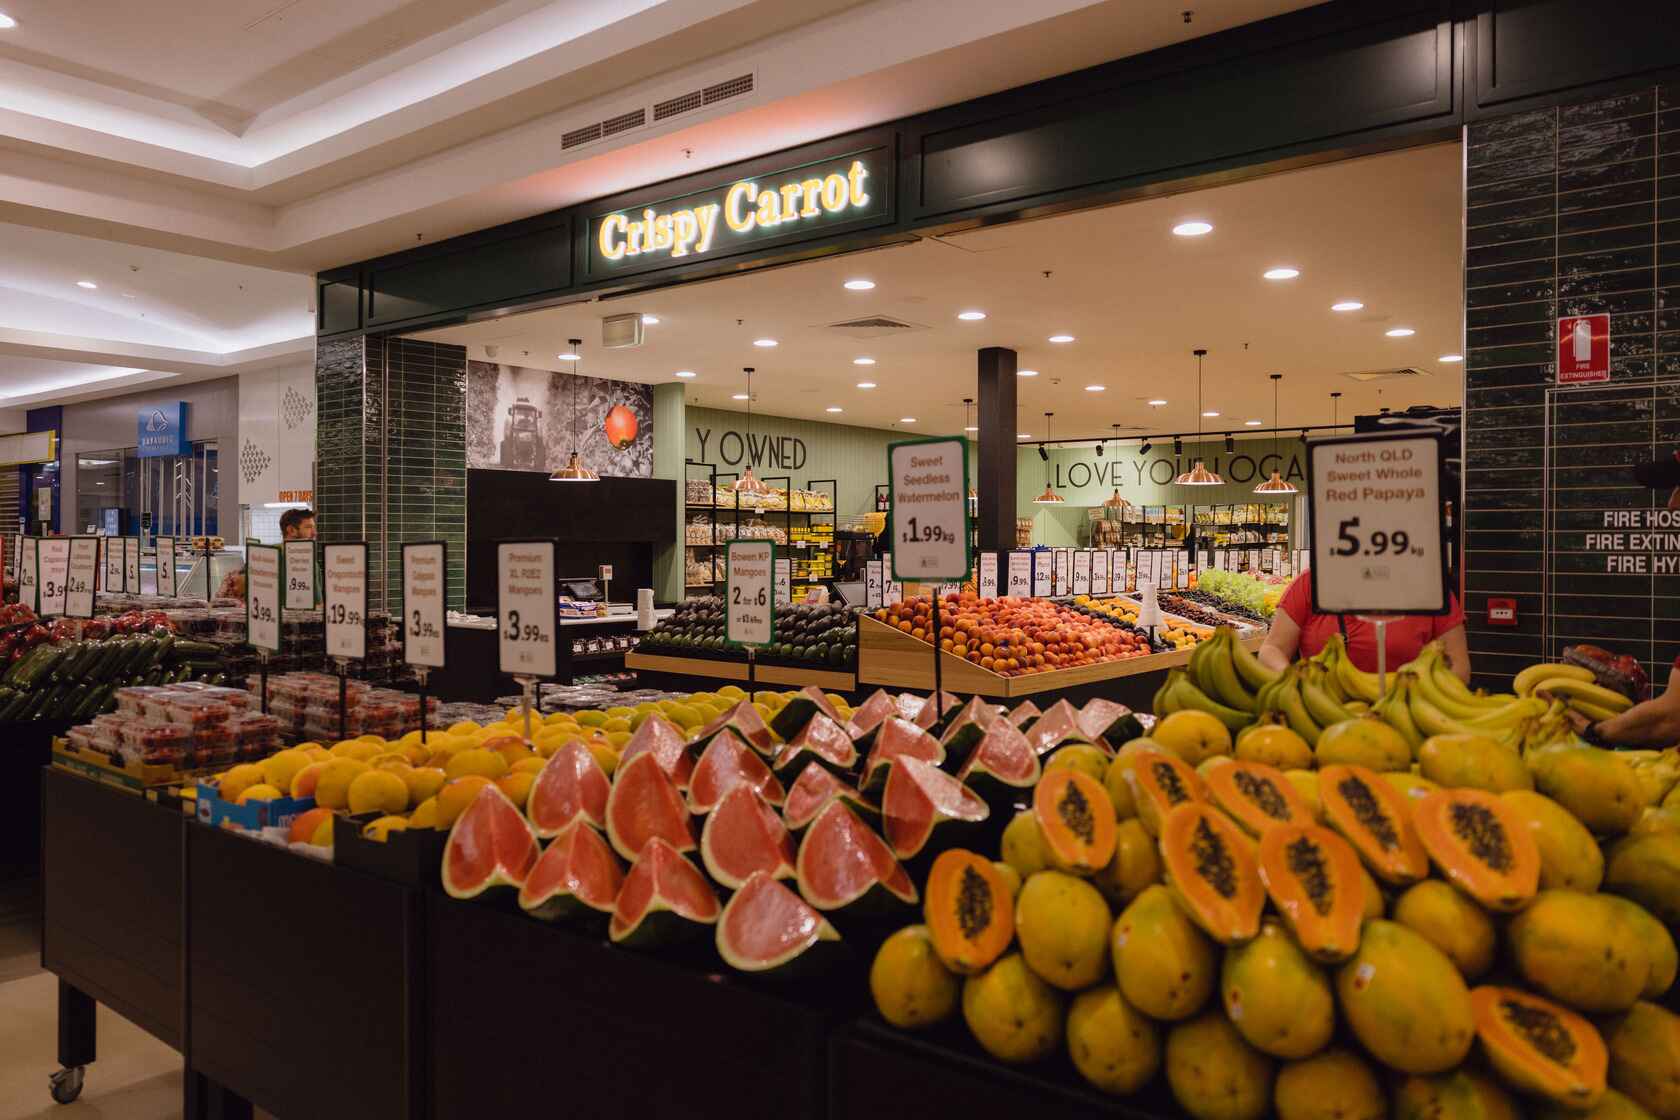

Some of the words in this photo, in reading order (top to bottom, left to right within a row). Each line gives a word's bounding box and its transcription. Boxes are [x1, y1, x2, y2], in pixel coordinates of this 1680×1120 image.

[599, 202, 720, 260] Crispy
[724, 160, 871, 232] Carrot
[720, 431, 807, 470] OWNED
[1335, 450, 1376, 464] North
[1380, 448, 1413, 462] QLD
[911, 456, 943, 468] Sweet
[1056, 461, 1124, 488] LOVE
[1214, 454, 1305, 484] LOCA
[1327, 469, 1371, 483] Sweet
[1376, 467, 1423, 480] Whole
[904, 473, 950, 486] Seedless
[898, 490, 960, 504] Watermelon
[1326, 488, 1358, 502] Red
[1362, 486, 1425, 502] Papaya
[1604, 511, 1641, 527] FIRE
[1585, 534, 1625, 550] FIRE
[508, 552, 543, 563] Premium
[731, 552, 757, 561] Bowen
[758, 552, 769, 560] KP
[1607, 555, 1647, 573] FIRE
[1653, 556, 1680, 573] HY
[734, 567, 767, 578] Mangoes
[733, 586, 741, 605] 2
